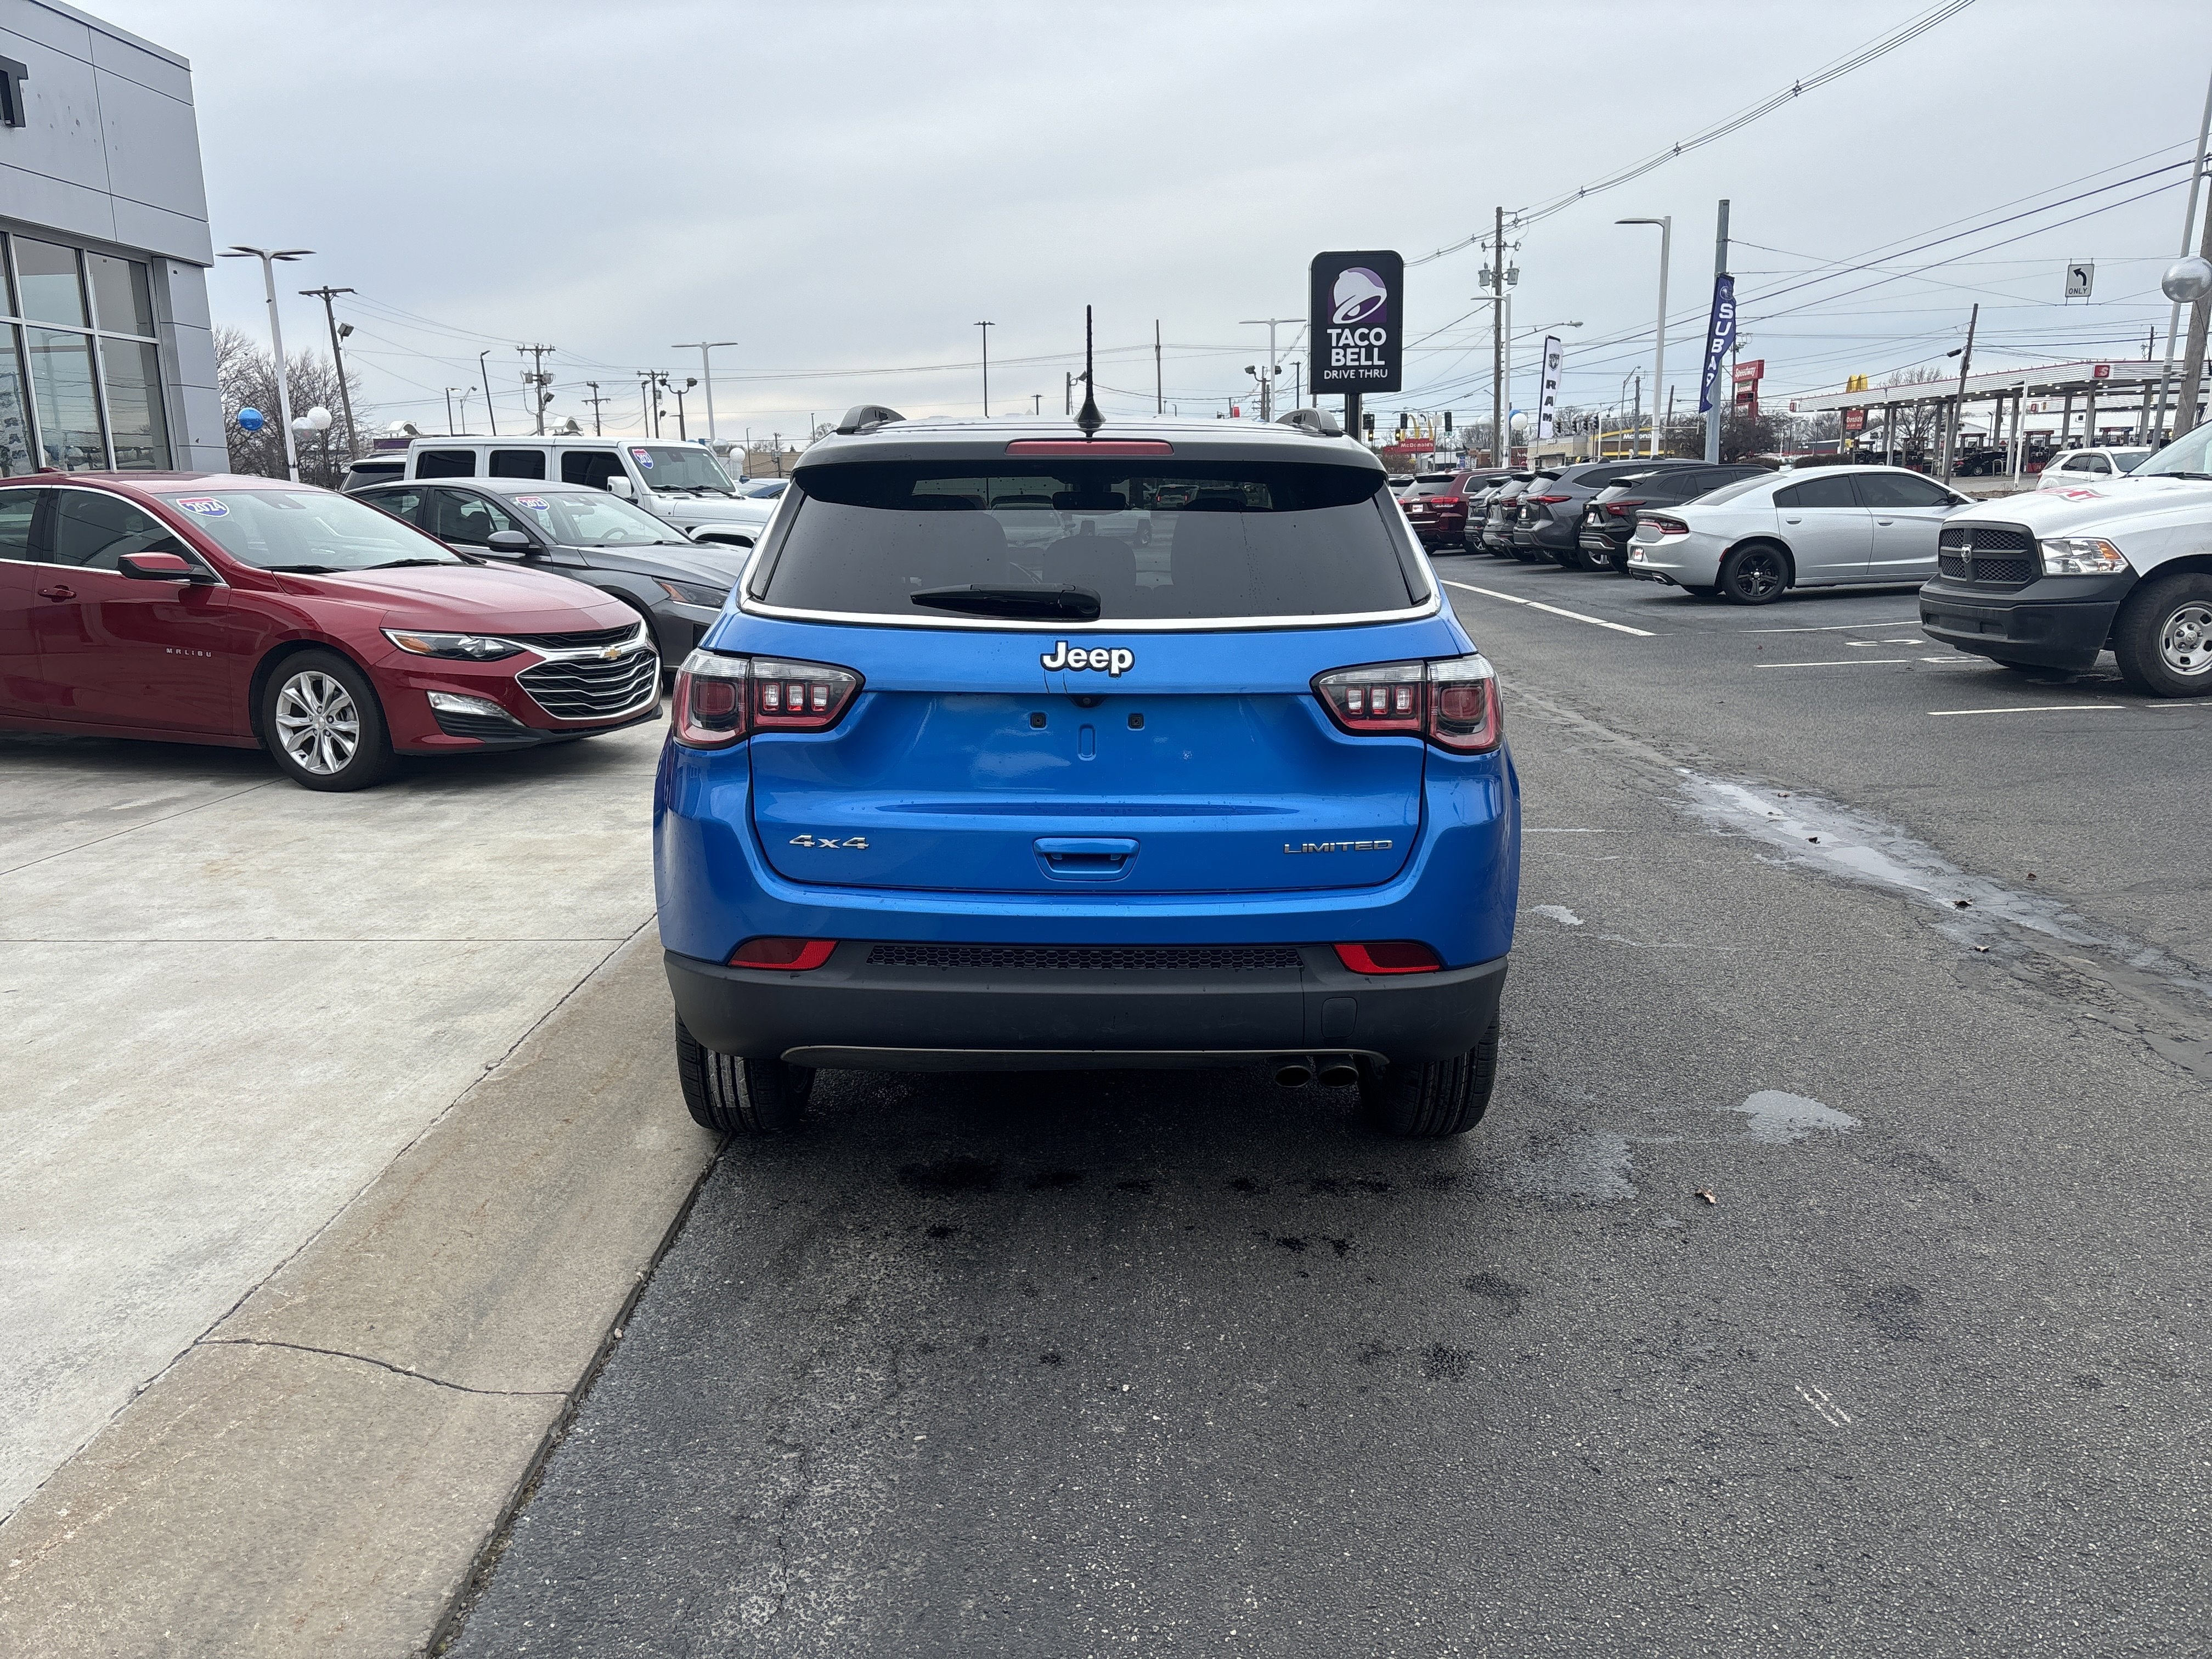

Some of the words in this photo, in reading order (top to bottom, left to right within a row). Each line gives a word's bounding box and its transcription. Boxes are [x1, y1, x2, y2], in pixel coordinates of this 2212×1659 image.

[1327, 328, 1387, 346] TACO
[1331, 348, 1385, 366] BELL
[1324, 370, 1356, 379] DRIVE
[1358, 369, 1388, 378] THRU
[1735, 366, 1756, 380] Speedway
[1542, 380, 1556, 422] RAM
[186, 501, 227, 512] 2024
[166, 648, 212, 657] MALIBU
[1041, 641, 1134, 676] Jeep
[789, 834, 870, 849] 4x4
[1284, 840, 1392, 854] LIMITED
